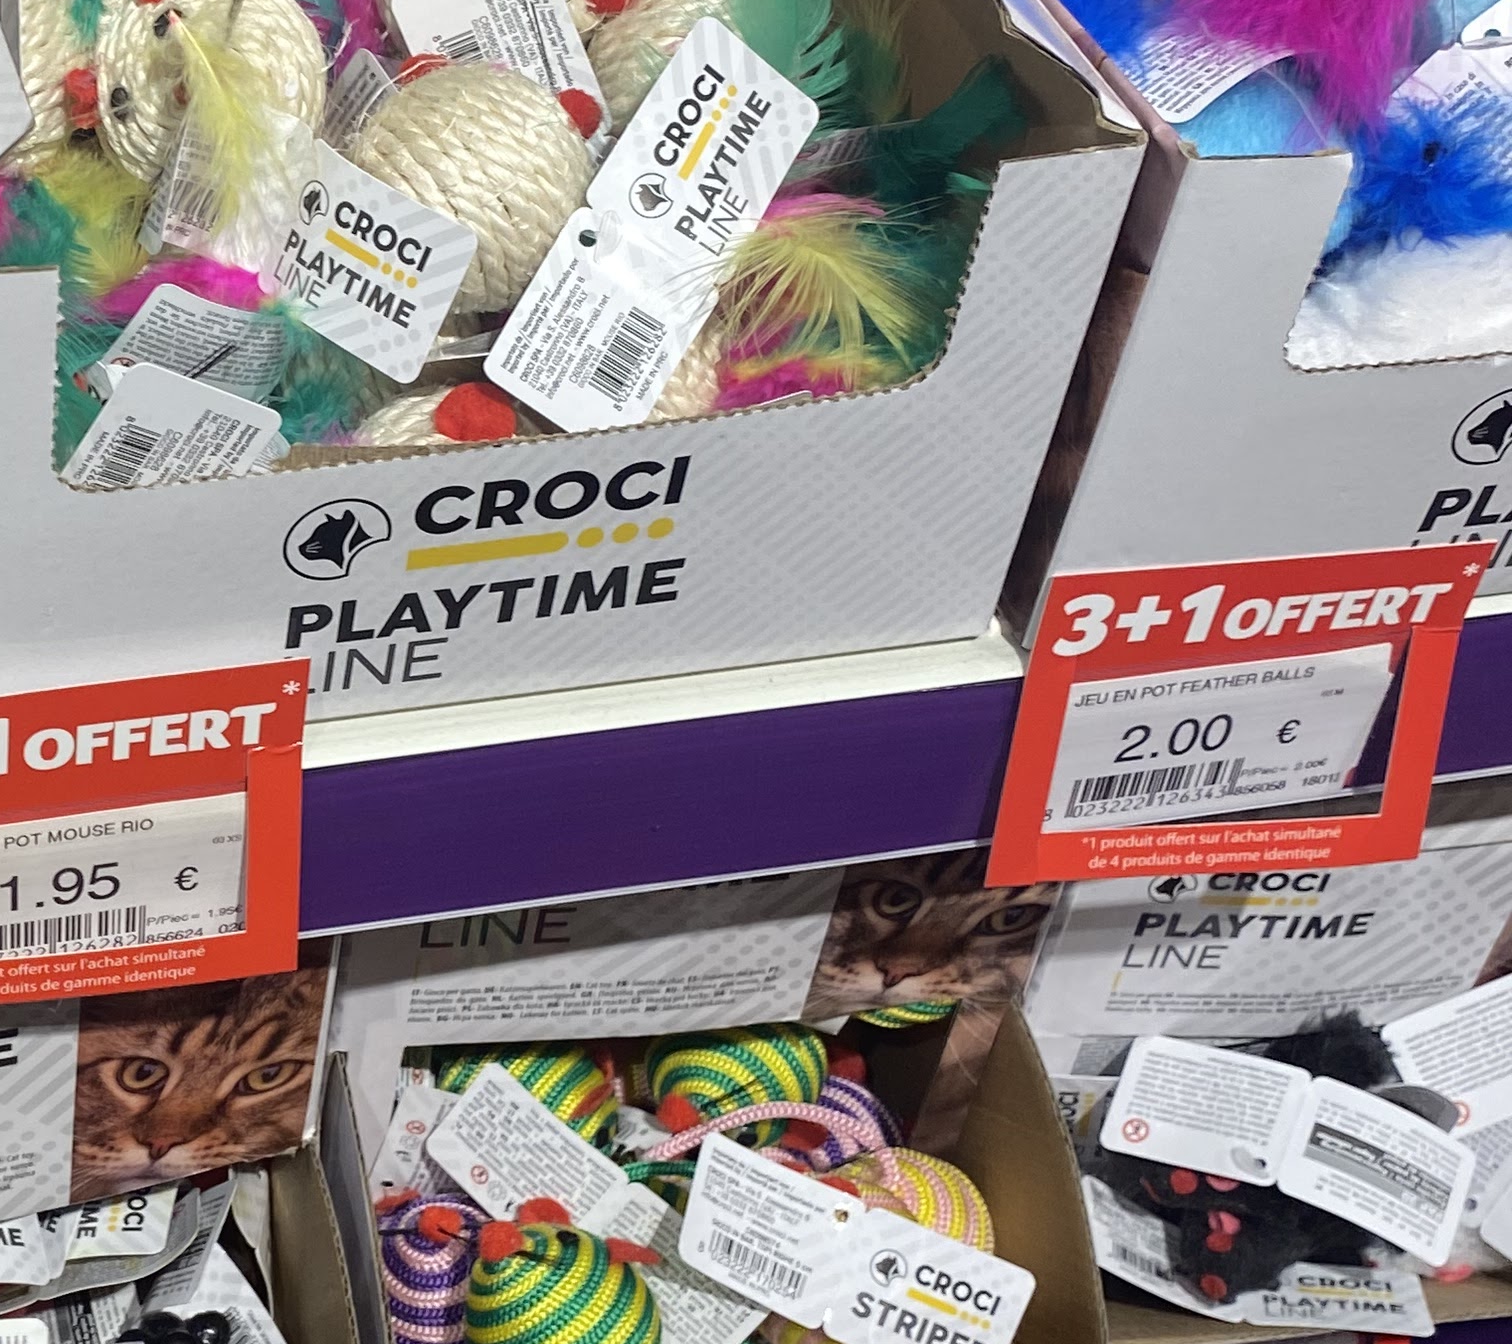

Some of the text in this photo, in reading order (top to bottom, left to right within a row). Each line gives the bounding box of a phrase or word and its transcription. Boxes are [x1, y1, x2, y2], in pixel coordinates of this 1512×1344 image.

[654, 64, 726, 167] CROCI
[674, 90, 772, 241] PLAYTIME
[334, 201, 433, 272] CROCI
[699, 186, 749, 257] LINE
[273, 254, 326, 309] LINE
[284, 228, 417, 329] PLAYTIME
[413, 454, 692, 536] CROCI
[284, 556, 686, 650] PLAYTIME
[1052, 585, 1225, 656] 3+1
[308, 637, 449, 694] INE
[1074, 666, 1316, 707] JEU EN POT FEATHER BALLS
[1113, 713, 1301, 764] 2.00 €
[4, 831, 43, 850] POT
[47, 822, 116, 846] MOUSE
[121, 817, 154, 835] RIO
[1089, 844, 1331, 869] de 4 produits de gamme identique
[1100, 825, 1342, 851] produit offert sur l'achat simultané
[0, 862, 199, 911] 1.95 €
[1207, 872, 1331, 893] CROCI
[420, 907, 578, 949] LINE
[1133, 912, 1375, 939] PLAYTIME
[8, 959, 48, 977] offert
[53, 959, 75, 974] sur
[80, 952, 128, 972] l'achat
[133, 944, 206, 967] simultané
[40, 978, 59, 992] de
[63, 975, 119, 993] gamme
[123, 964, 196, 989] identique
[1122, 944, 1229, 970] LINE
[915, 1264, 1002, 1317] CROCI
[1262, 1294, 1406, 1315] PLAYTIME
[1298, 1276, 1392, 1293] CROCI
